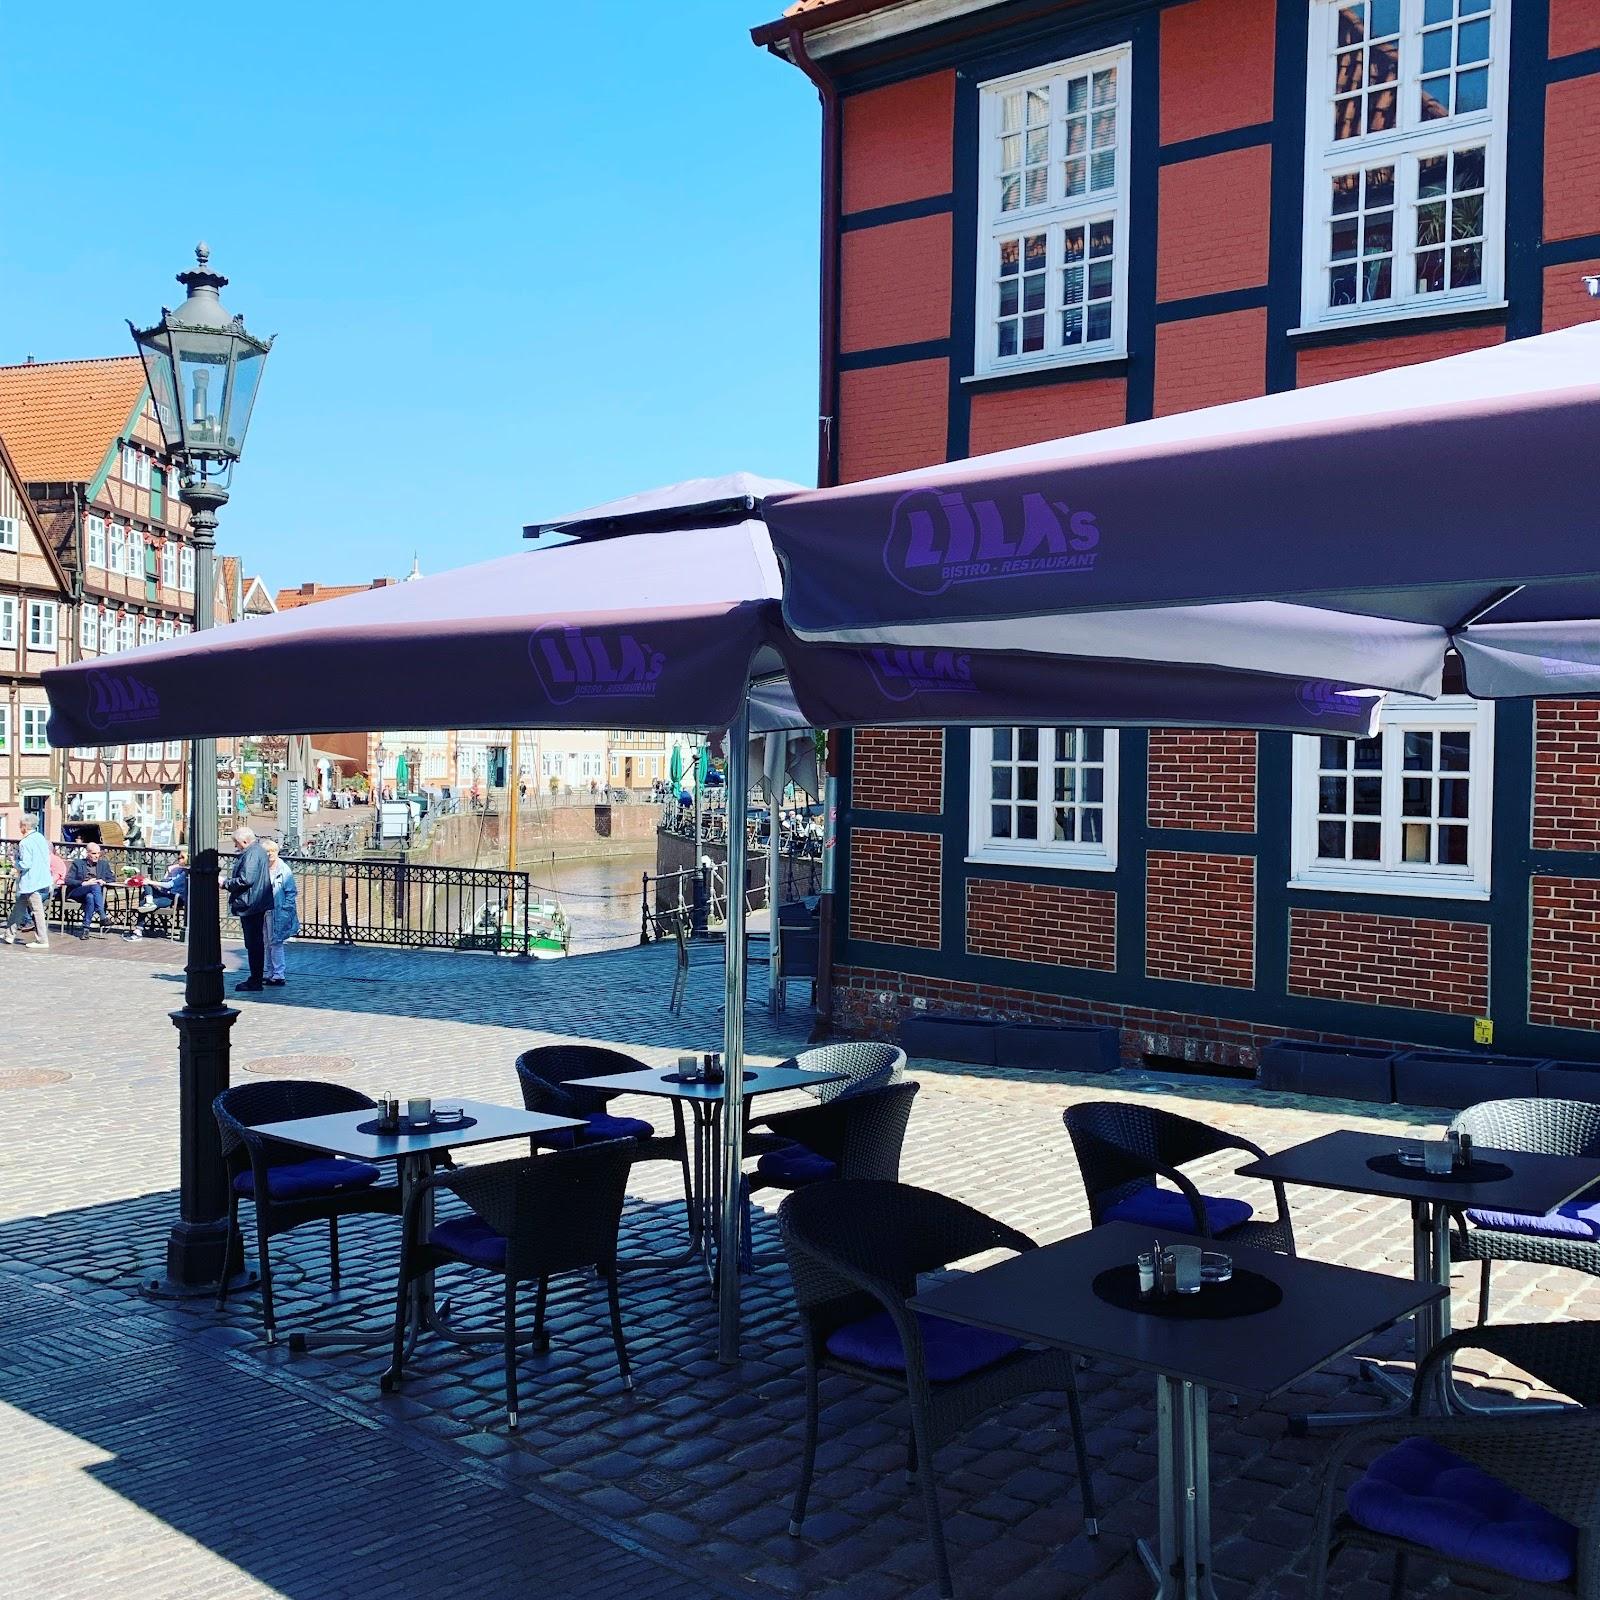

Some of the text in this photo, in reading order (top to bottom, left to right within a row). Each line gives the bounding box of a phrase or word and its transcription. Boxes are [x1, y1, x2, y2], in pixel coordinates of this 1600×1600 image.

[942, 563, 990, 579] BISTRO
[1001, 552, 1098, 572] RESTAURANT
[290, 781, 298, 828] KUNSTHAUS
